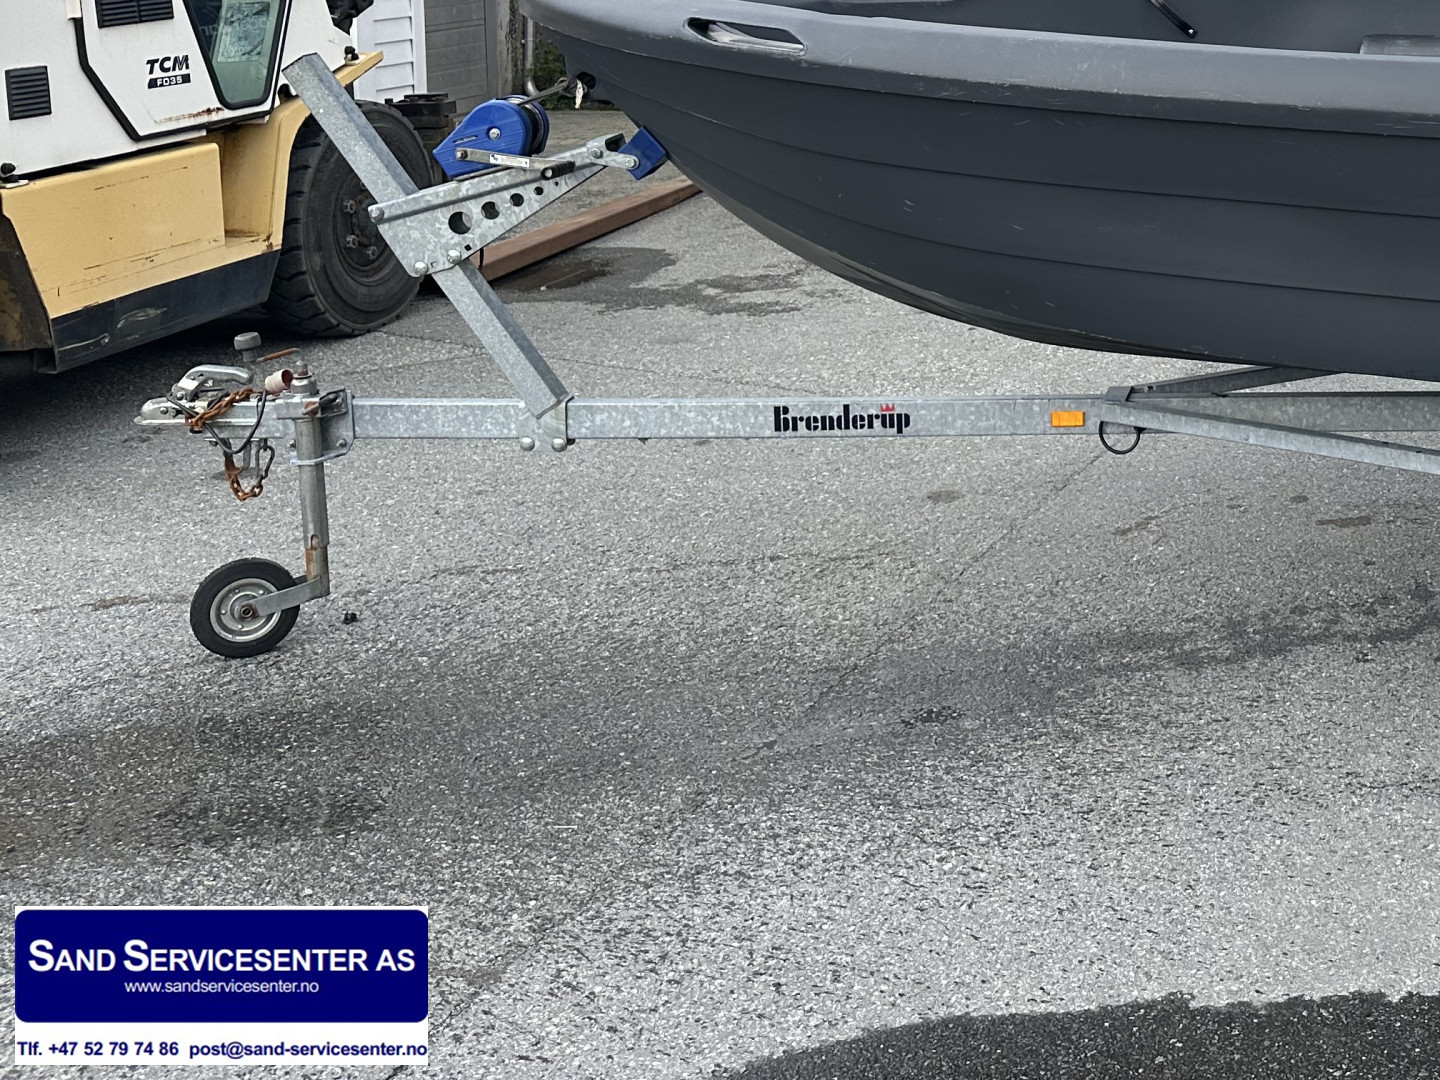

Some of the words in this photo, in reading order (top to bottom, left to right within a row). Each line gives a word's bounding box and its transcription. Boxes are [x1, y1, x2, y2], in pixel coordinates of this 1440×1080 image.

[146, 55, 190, 75] TCM
[156, 75, 183, 87] FD35
[773, 403, 911, 435] Brenderup
